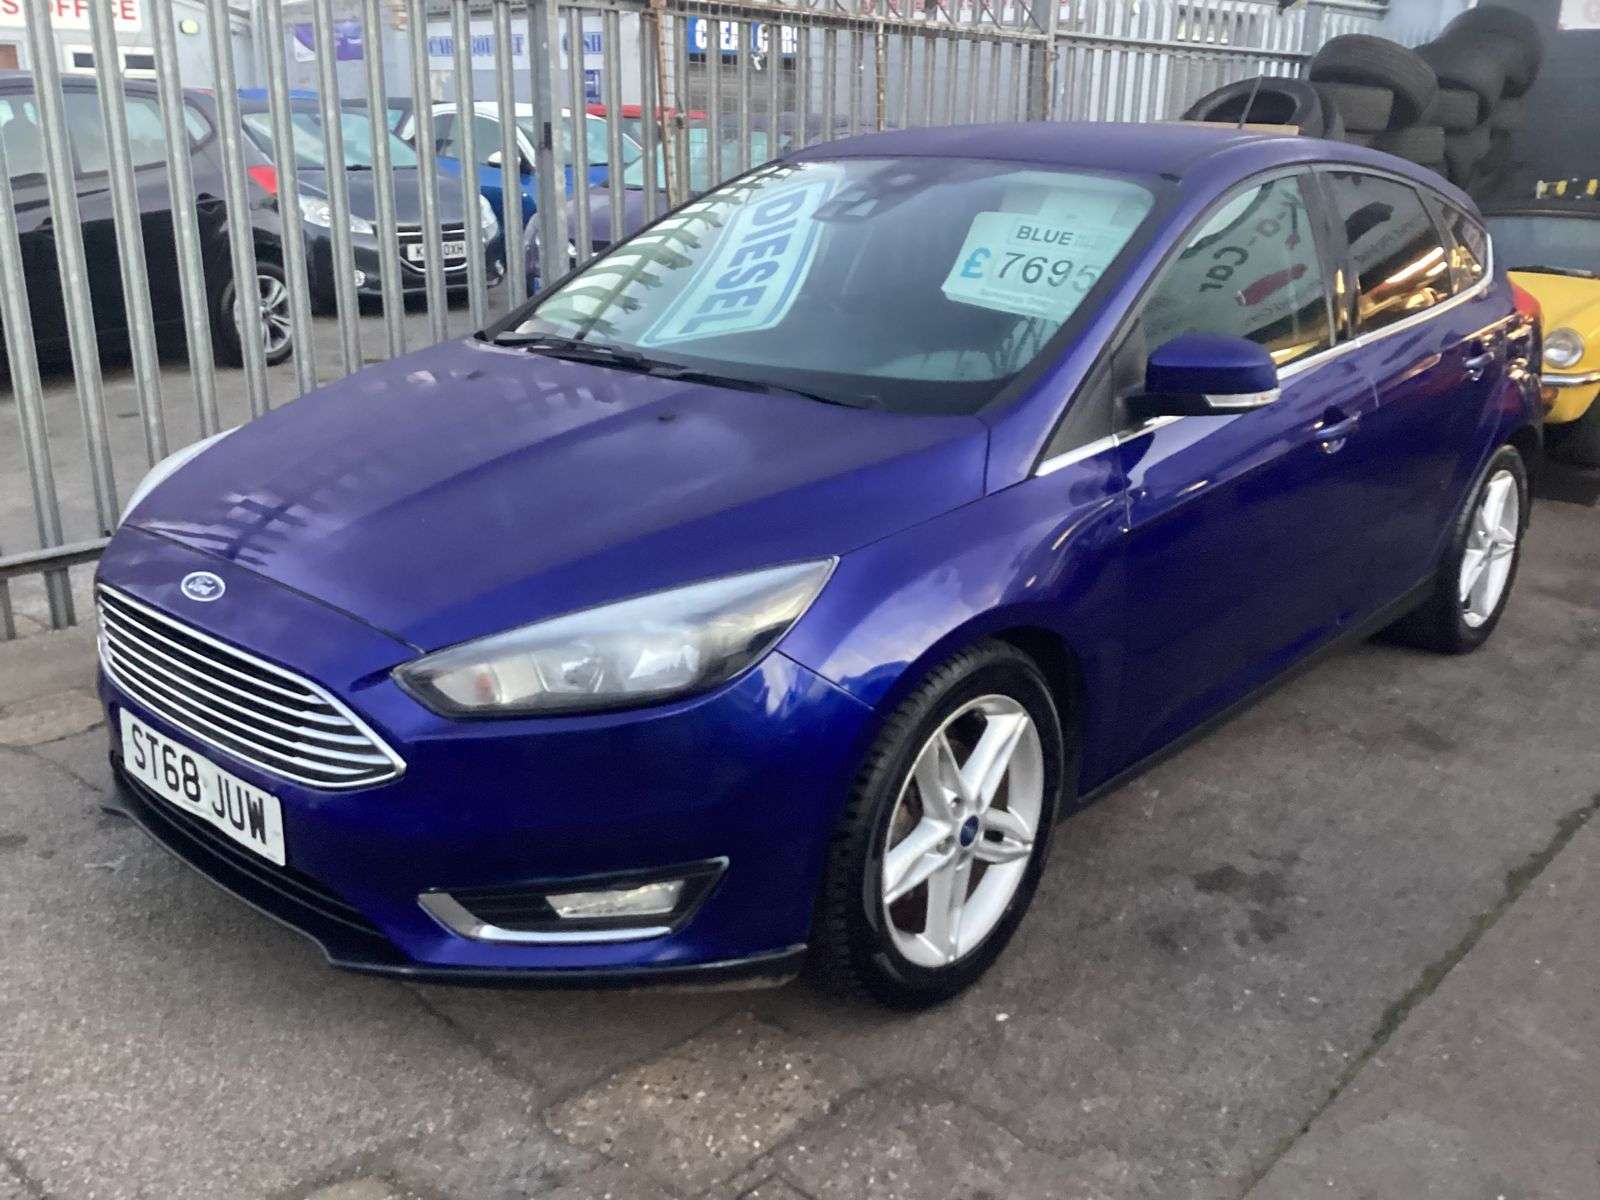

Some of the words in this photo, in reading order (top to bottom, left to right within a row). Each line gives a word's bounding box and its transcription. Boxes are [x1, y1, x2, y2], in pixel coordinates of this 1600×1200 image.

[678, 189, 808, 334] DIESEL
[1016, 225, 1074, 246] BLUE
[130, 723, 201, 802] ST68
[212, 774, 267, 845] JUW
